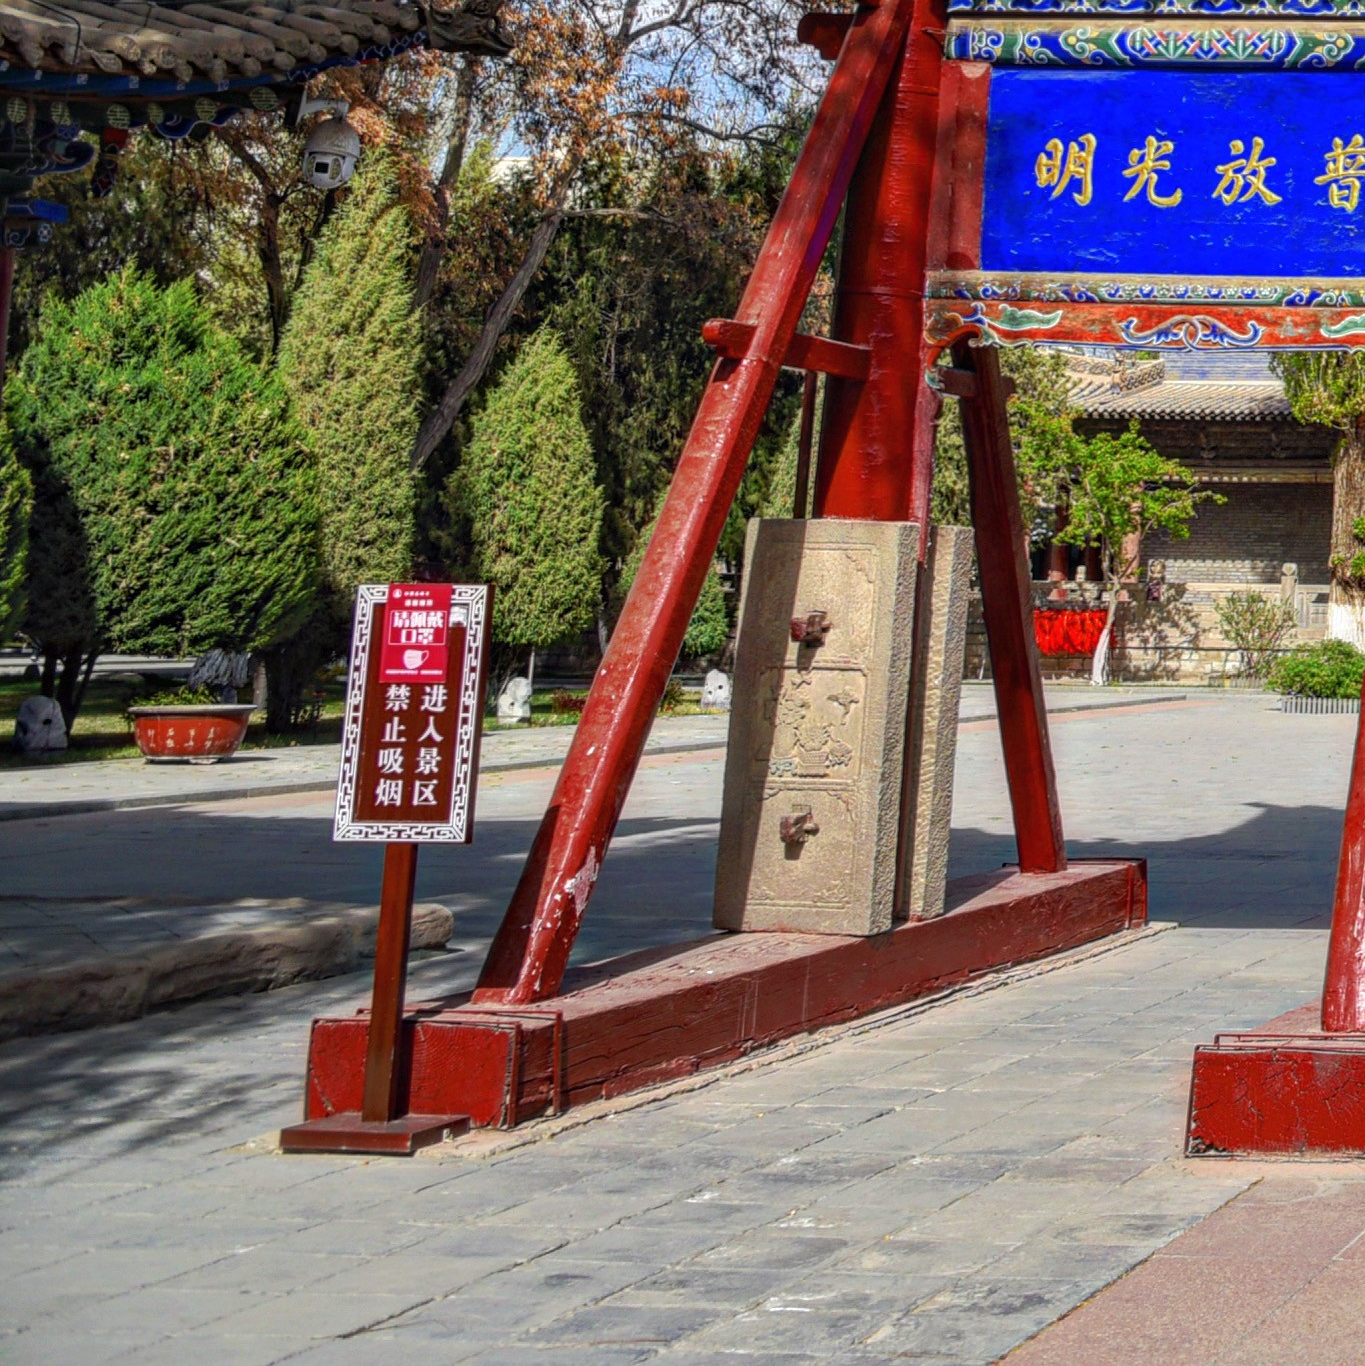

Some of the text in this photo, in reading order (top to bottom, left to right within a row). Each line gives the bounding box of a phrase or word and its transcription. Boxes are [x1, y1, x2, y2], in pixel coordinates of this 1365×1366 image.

[393, 610, 443, 628] 请佩戴
[401, 628, 435, 644] 口罩
[375, 685, 411, 806] 禁止吸烟
